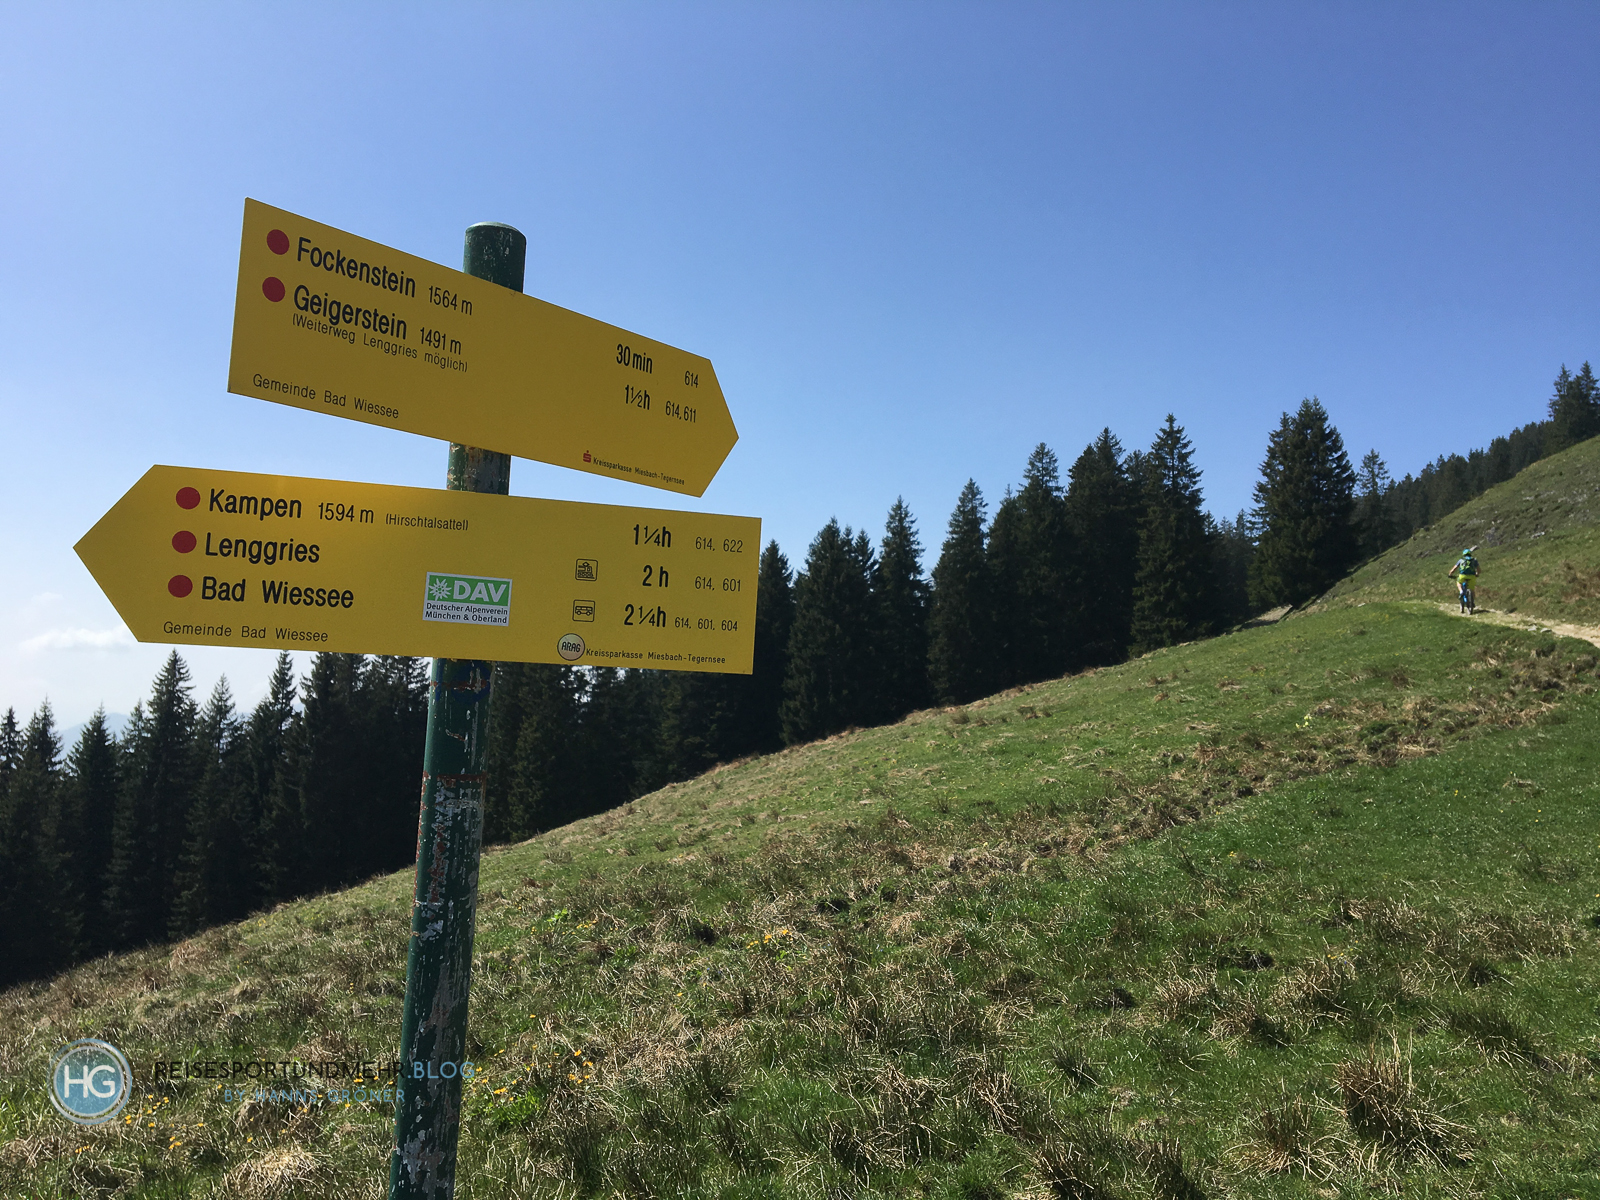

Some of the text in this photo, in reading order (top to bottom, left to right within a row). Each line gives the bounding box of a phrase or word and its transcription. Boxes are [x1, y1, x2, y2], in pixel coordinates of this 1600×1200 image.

[297, 236, 473, 316] Fockenstein 1564 m
[293, 284, 462, 355] Geigerstein 1491 m
[292, 313, 468, 373] (Weiterweg Lenggries möglich)
[616, 343, 653, 374] 30 min
[684, 370, 699, 388] 614
[252, 373, 399, 419] Gemeinde Bad Wiessee
[593, 457, 685, 486] Kreissparkasse Miesbach-Tegernsee
[208, 488, 469, 531] Kampen 1594 m (Hirschtalsattel)
[205, 532, 320, 566] Lenggries
[722, 538, 744, 553] 622
[642, 564, 669, 588] 2 h
[722, 578, 742, 592] 601
[201, 576, 354, 608] Bad Wiessee
[452, 580, 507, 603] DAV
[425, 610, 461, 620] München
[472, 614, 507, 624] Oberland
[426, 602, 508, 616] Deutscher Alpenverein
[163, 621, 328, 642] Gemeinde Bad Wiessee
[721, 619, 738, 632] 604
[561, 641, 582, 653] ARAG
[586, 648, 726, 664] Kreissparkasse Miesbach-Tegernsee
